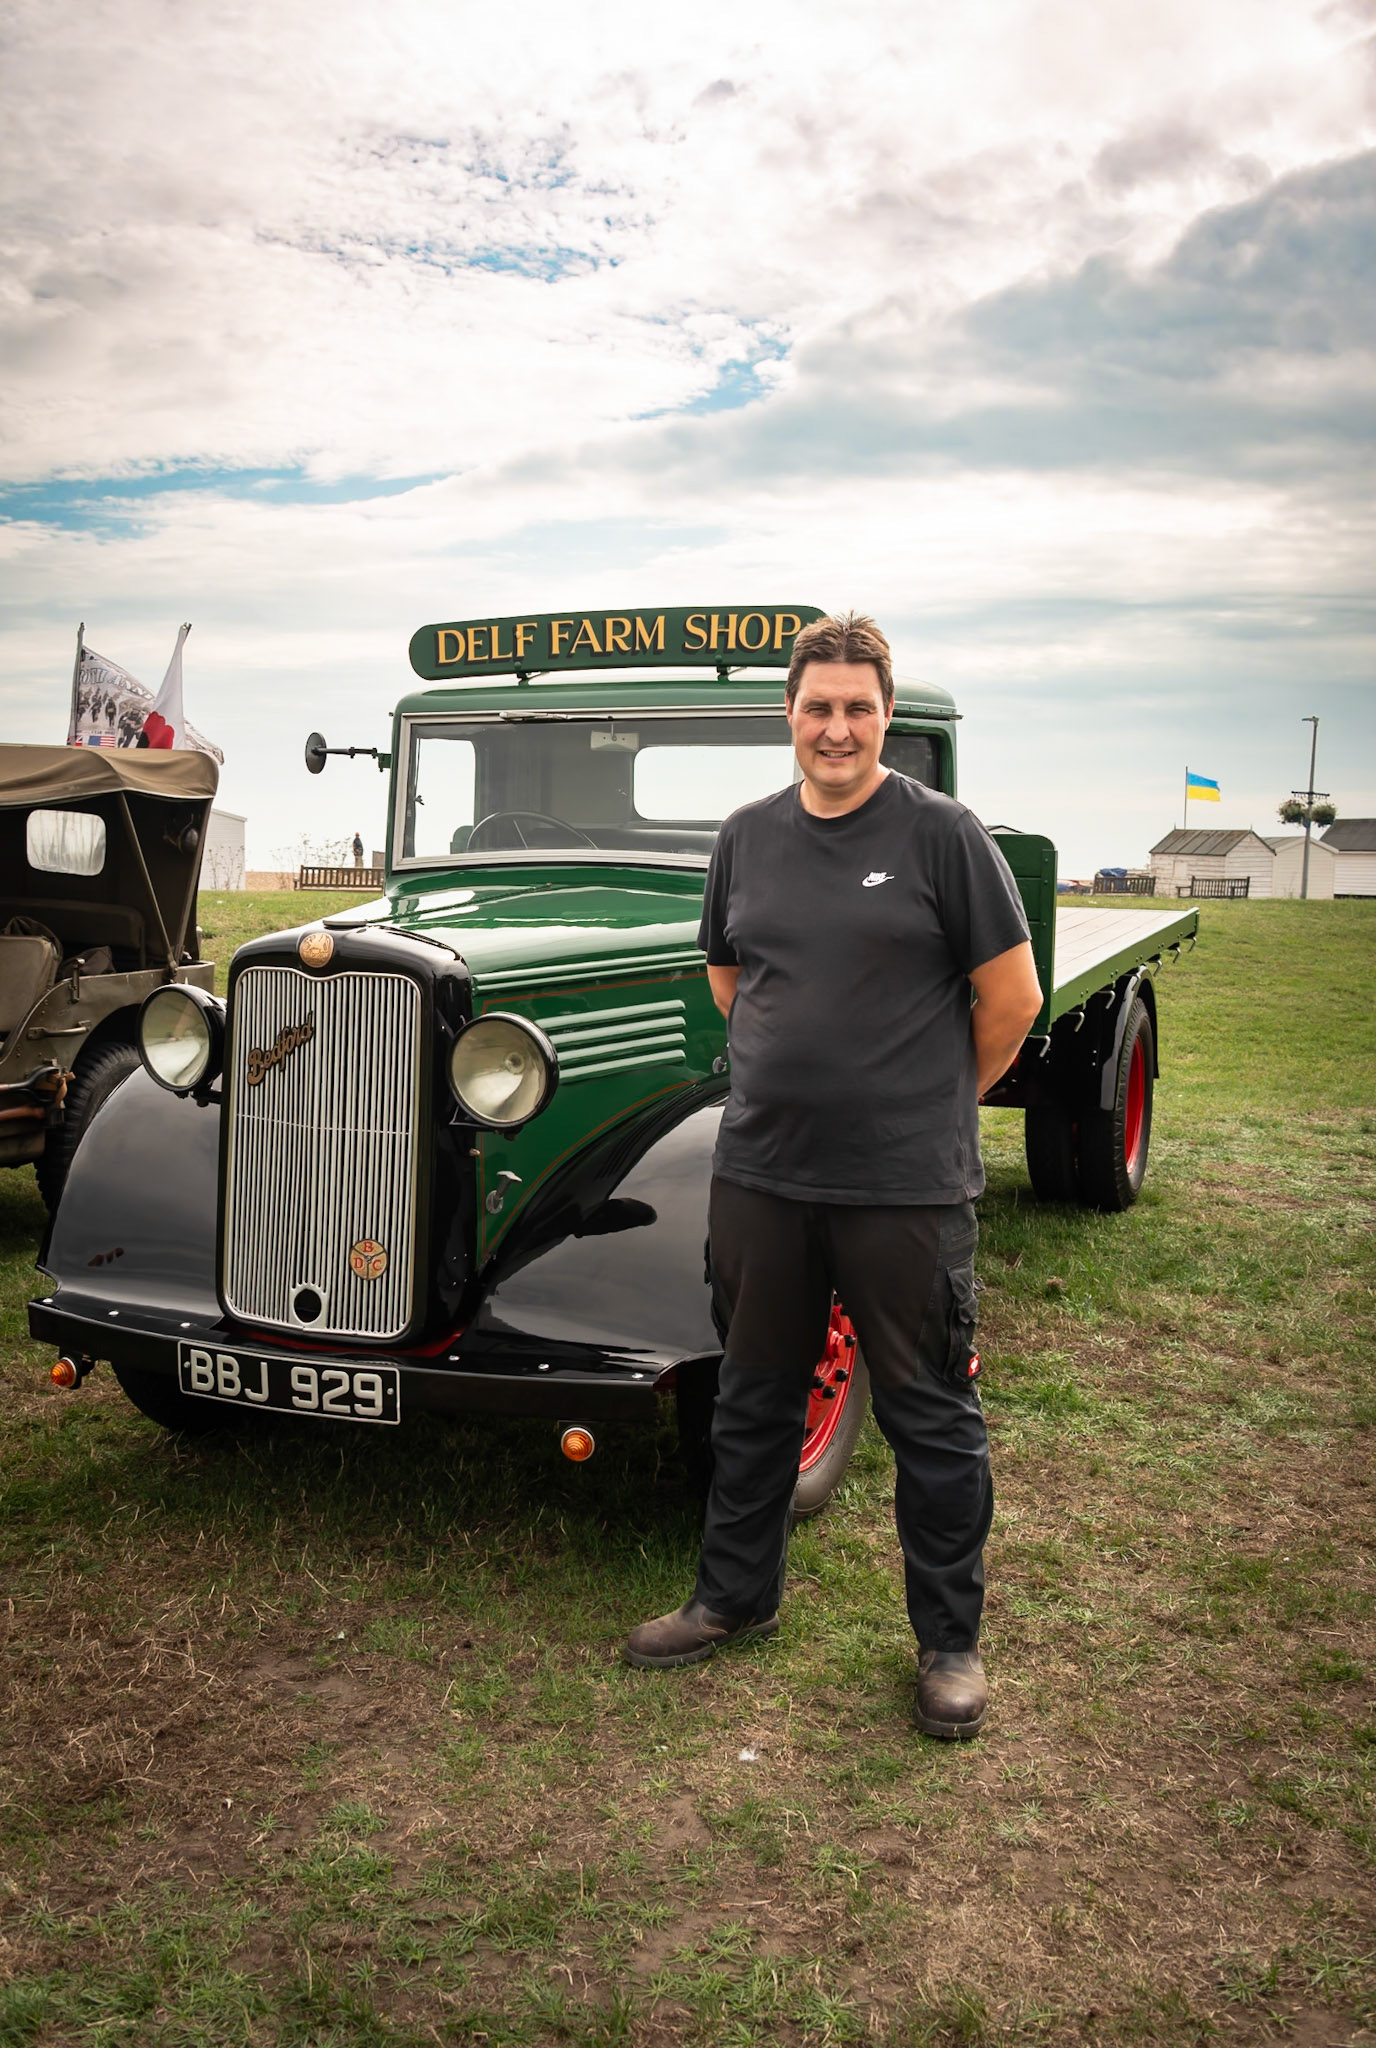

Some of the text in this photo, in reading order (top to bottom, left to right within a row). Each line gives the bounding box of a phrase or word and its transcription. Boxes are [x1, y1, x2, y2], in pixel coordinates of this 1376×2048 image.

[437, 613, 802, 664] DELF FARM SHOP
[247, 1010, 315, 1086] Bedford
[354, 1257, 382, 1271] D C
[363, 1241, 374, 1253] B
[190, 1349, 383, 1417] BBJ 929
